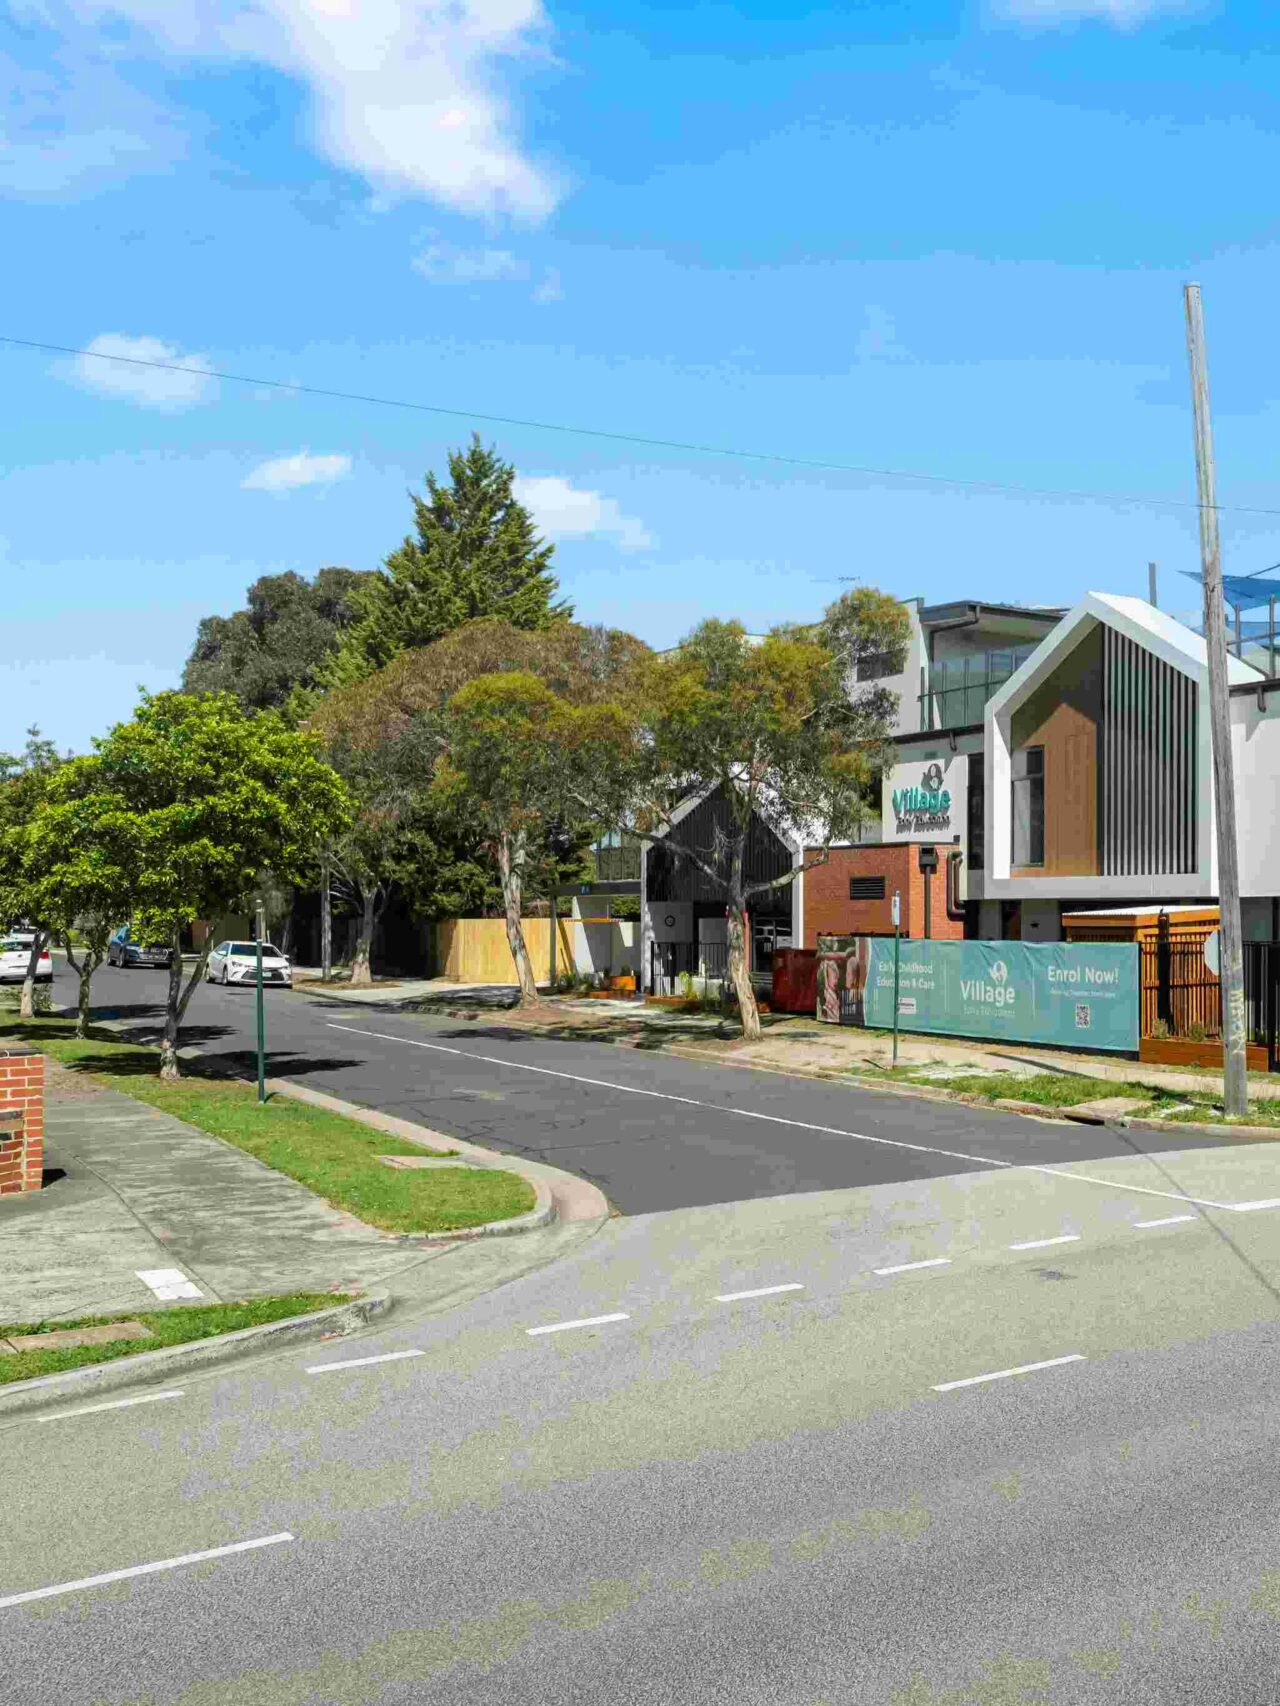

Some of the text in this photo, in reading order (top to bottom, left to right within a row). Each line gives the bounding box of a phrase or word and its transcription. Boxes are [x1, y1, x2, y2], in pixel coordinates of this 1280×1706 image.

[893, 786, 952, 816] Village
[1047, 965, 1119, 984] Enrol Now!
[960, 980, 1016, 1007] Village
